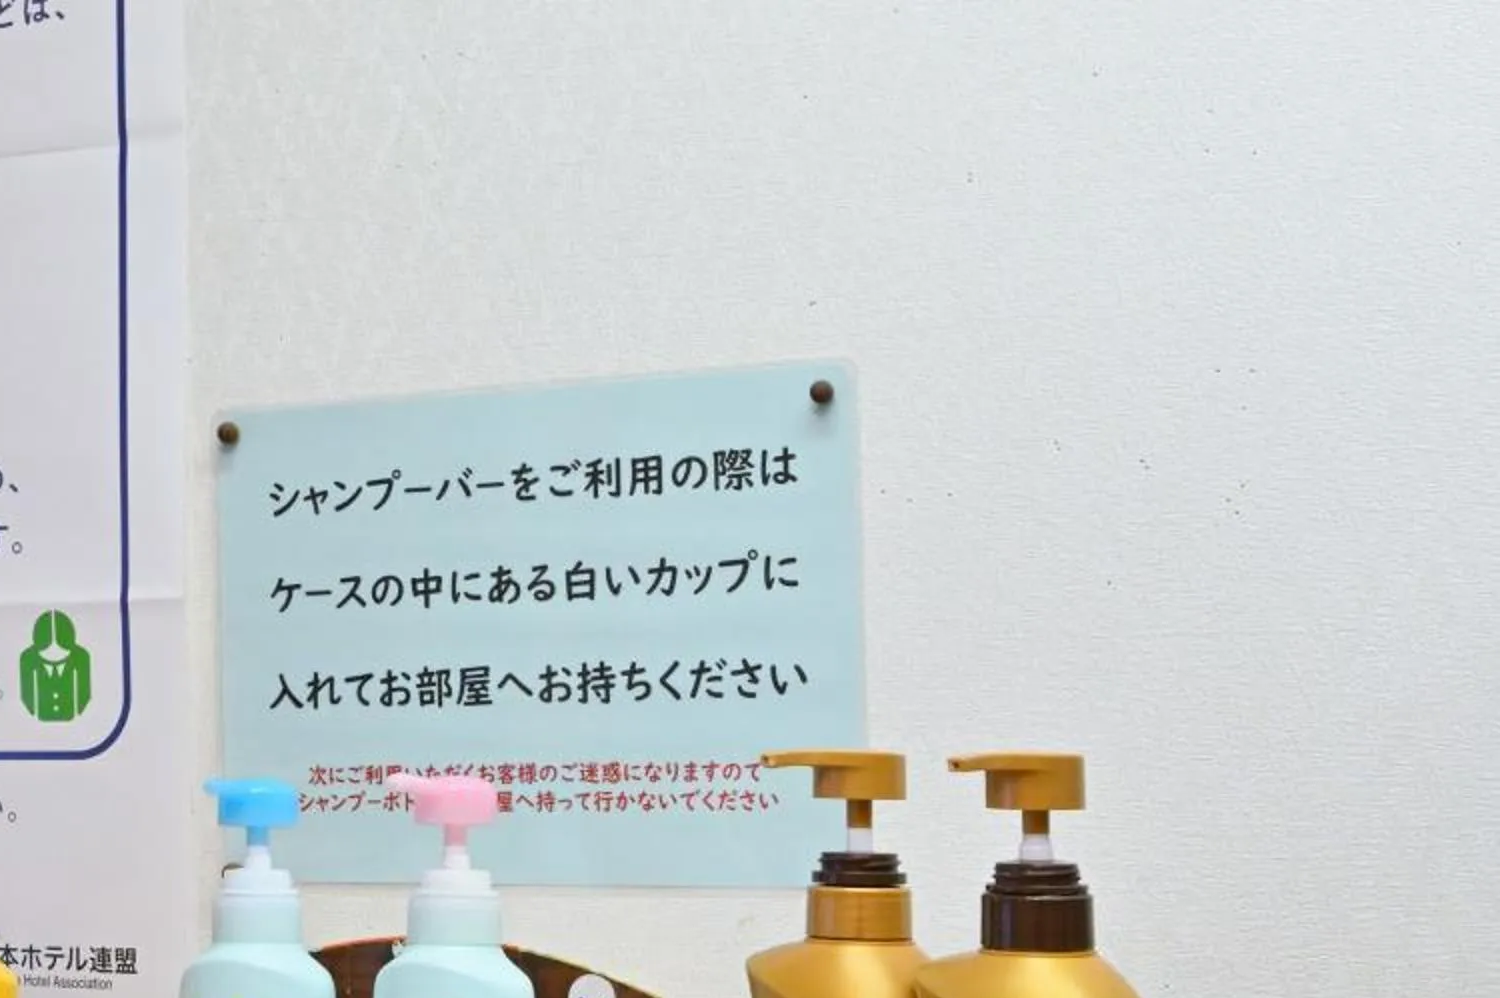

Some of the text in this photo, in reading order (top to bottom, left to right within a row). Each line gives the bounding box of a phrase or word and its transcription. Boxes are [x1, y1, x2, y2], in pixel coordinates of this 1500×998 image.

[270, 447, 798, 517] シャンプーバーをご利用の際は
[271, 549, 799, 612] ケースの中にある白いカップに
[270, 659, 807, 710] 入れてお部屋へお持ちください
[23, 975, 113, 990] Hotel Association
